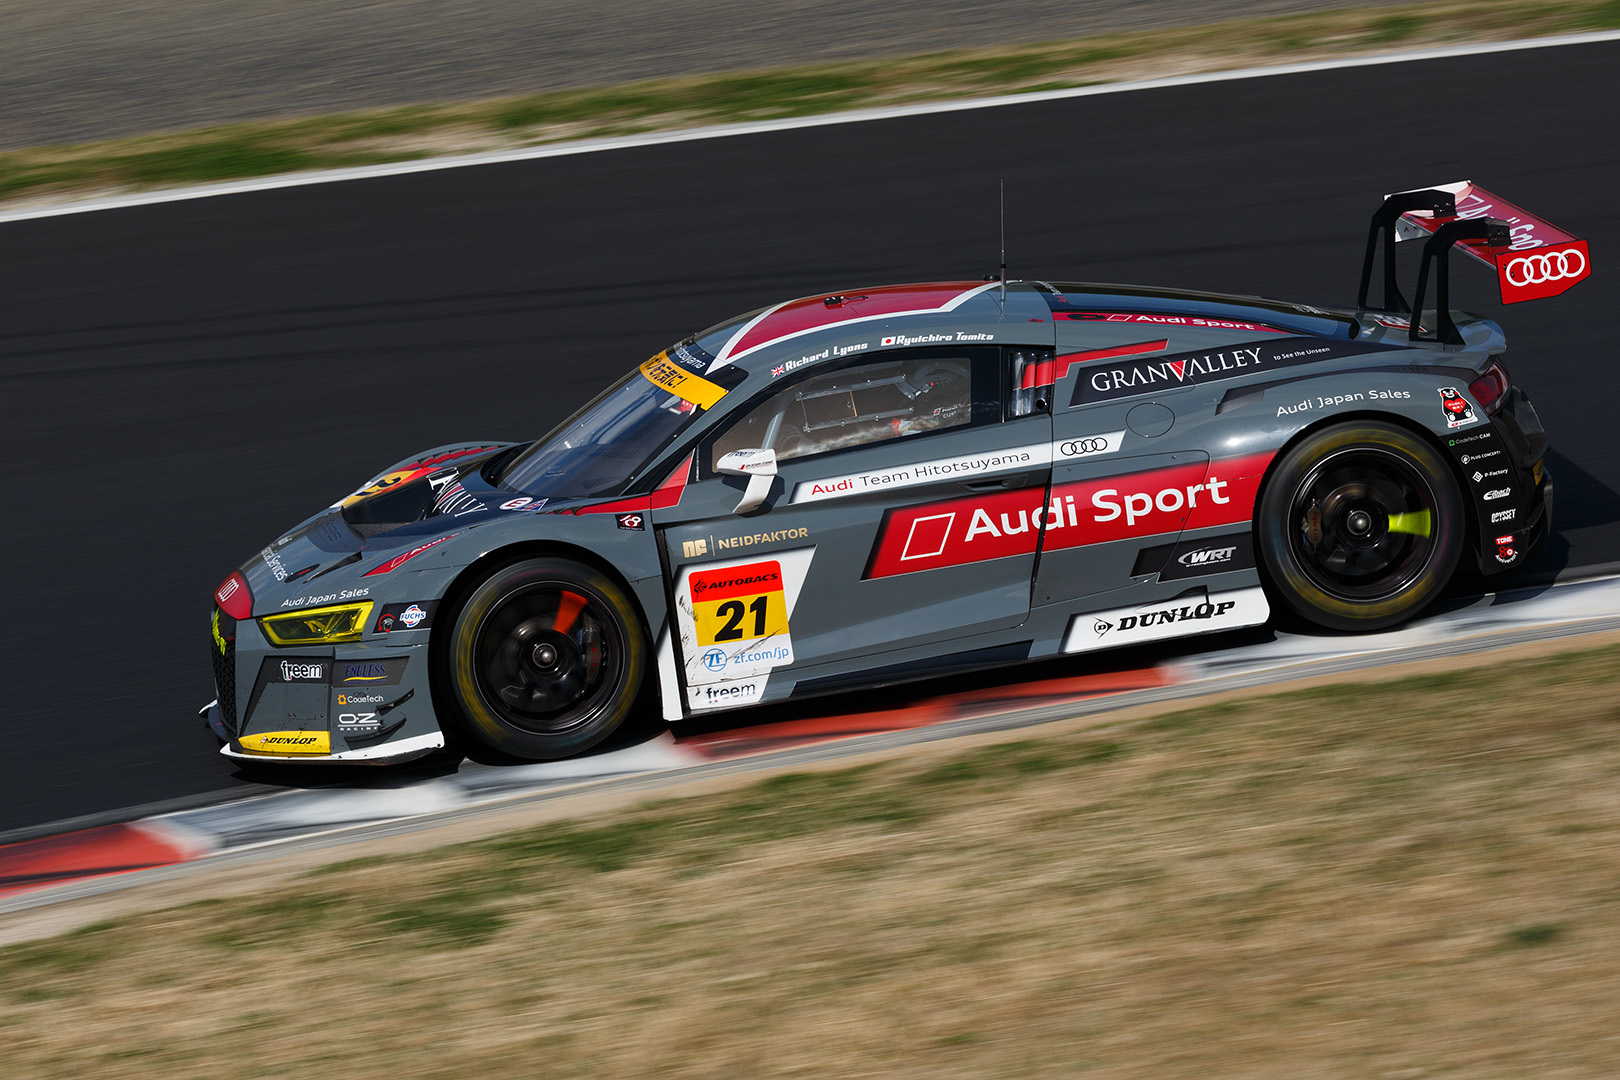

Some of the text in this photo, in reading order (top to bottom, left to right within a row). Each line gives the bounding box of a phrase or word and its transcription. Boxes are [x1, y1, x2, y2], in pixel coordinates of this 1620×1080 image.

[1136, 315, 1255, 329] Audi Sport
[896, 331, 994, 346] Ryuichiro Tomita
[785, 342, 868, 371] Richard Lyons
[1305, 347, 1331, 355] Unseen
[1091, 347, 1262, 391] GRANVALLEY
[1276, 389, 1411, 418] Audi Japan Sales
[811, 452, 1031, 495] Audi Team Hitotsuyama
[965, 476, 1230, 542] Audi Sport
[718, 527, 809, 550] NEIDFAKTOR
[1190, 546, 1237, 563] WRT
[708, 573, 779, 590] AUTOBACS
[280, 588, 369, 608] Audi Japan Sales
[400, 612, 425, 620] FUCHS
[714, 595, 768, 643] 21
[1116, 601, 1236, 631] DUNLOP
[733, 647, 790, 665] zf.com/jp
[280, 660, 323, 680] freem
[345, 664, 387, 677] ENDLESS
[706, 683, 756, 700] freem
[268, 736, 317, 745] DUNLOP
